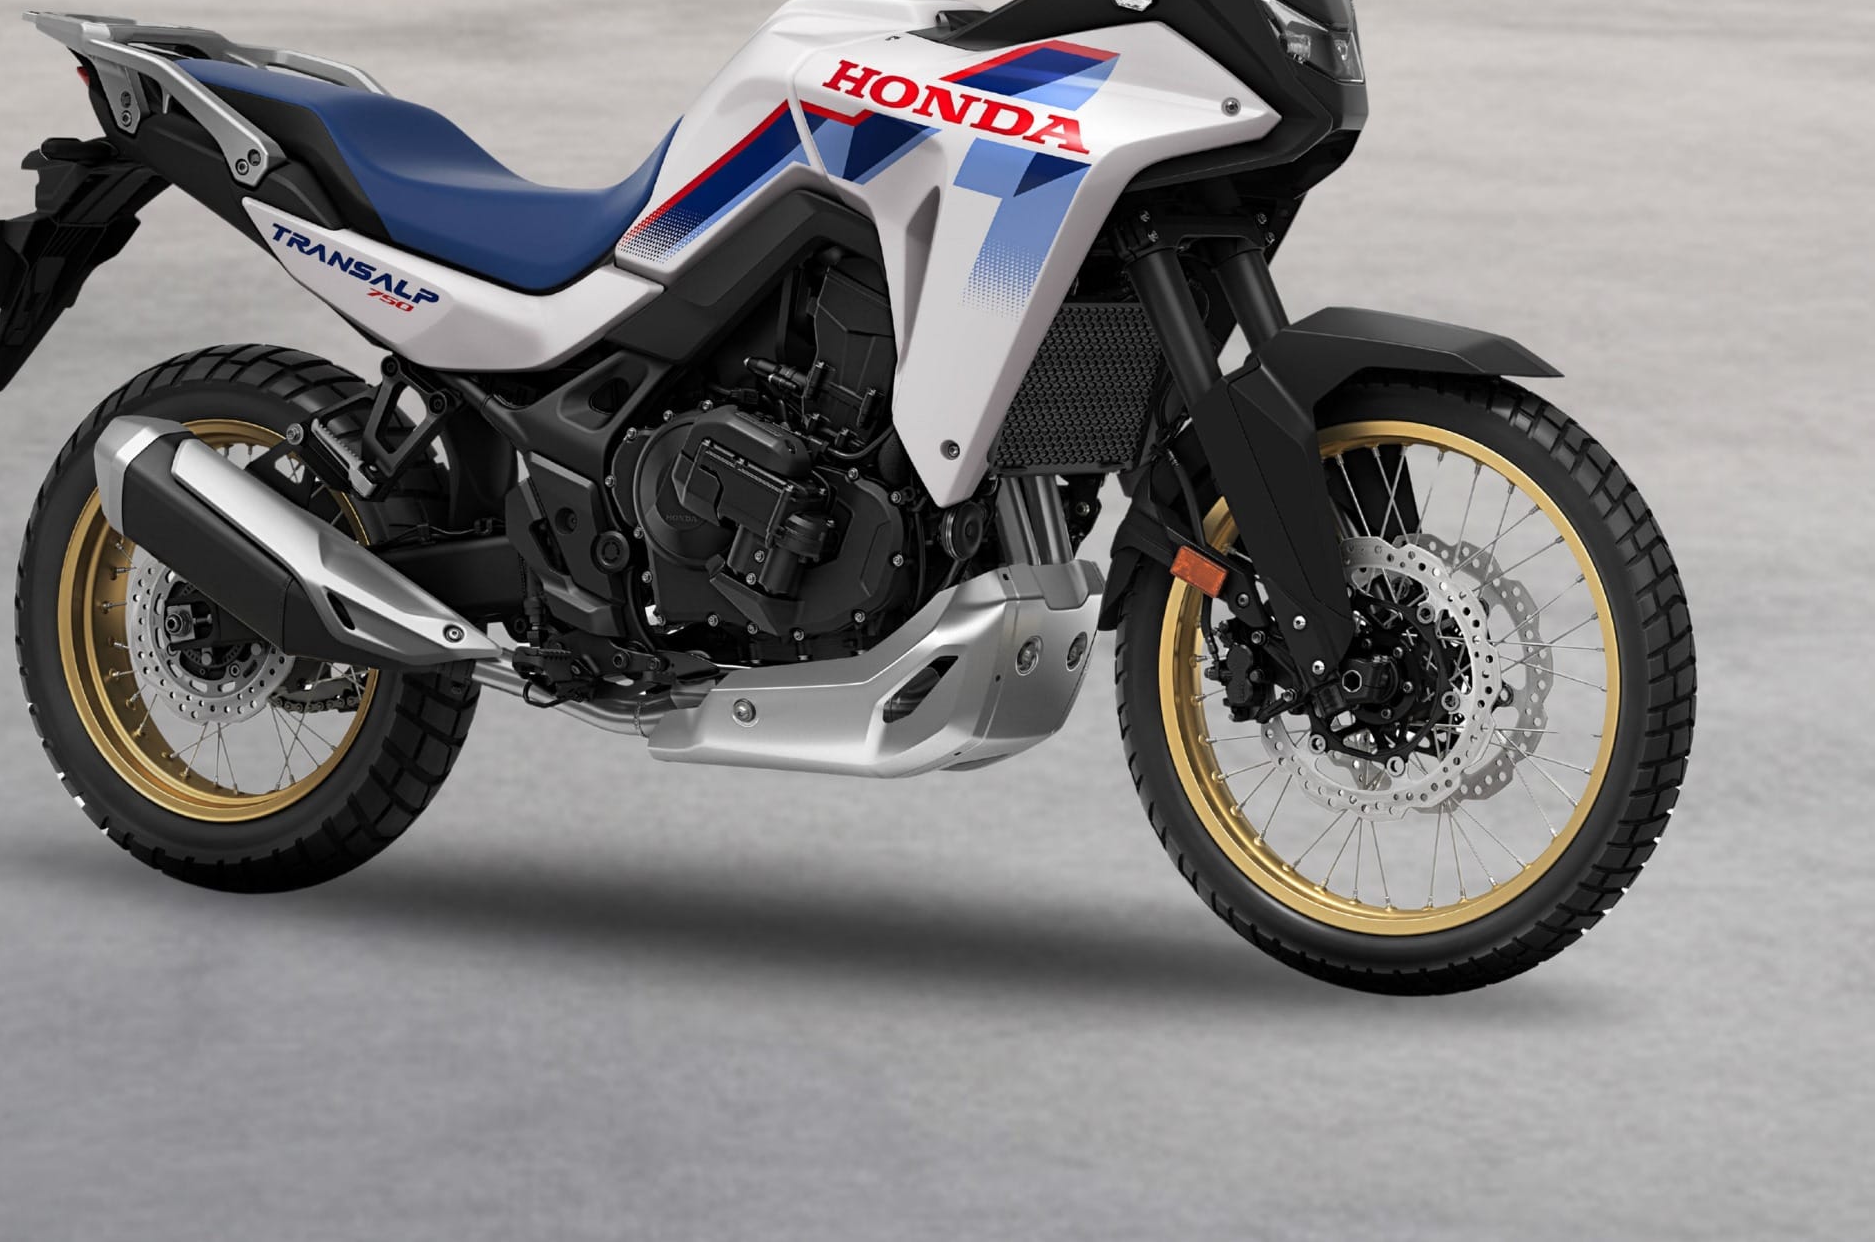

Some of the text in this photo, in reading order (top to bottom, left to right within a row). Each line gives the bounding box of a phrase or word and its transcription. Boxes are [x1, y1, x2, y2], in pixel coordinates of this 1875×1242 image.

[821, 59, 1090, 155] HONDA
[272, 223, 440, 305] TRANSALP
[366, 287, 415, 313] 750
